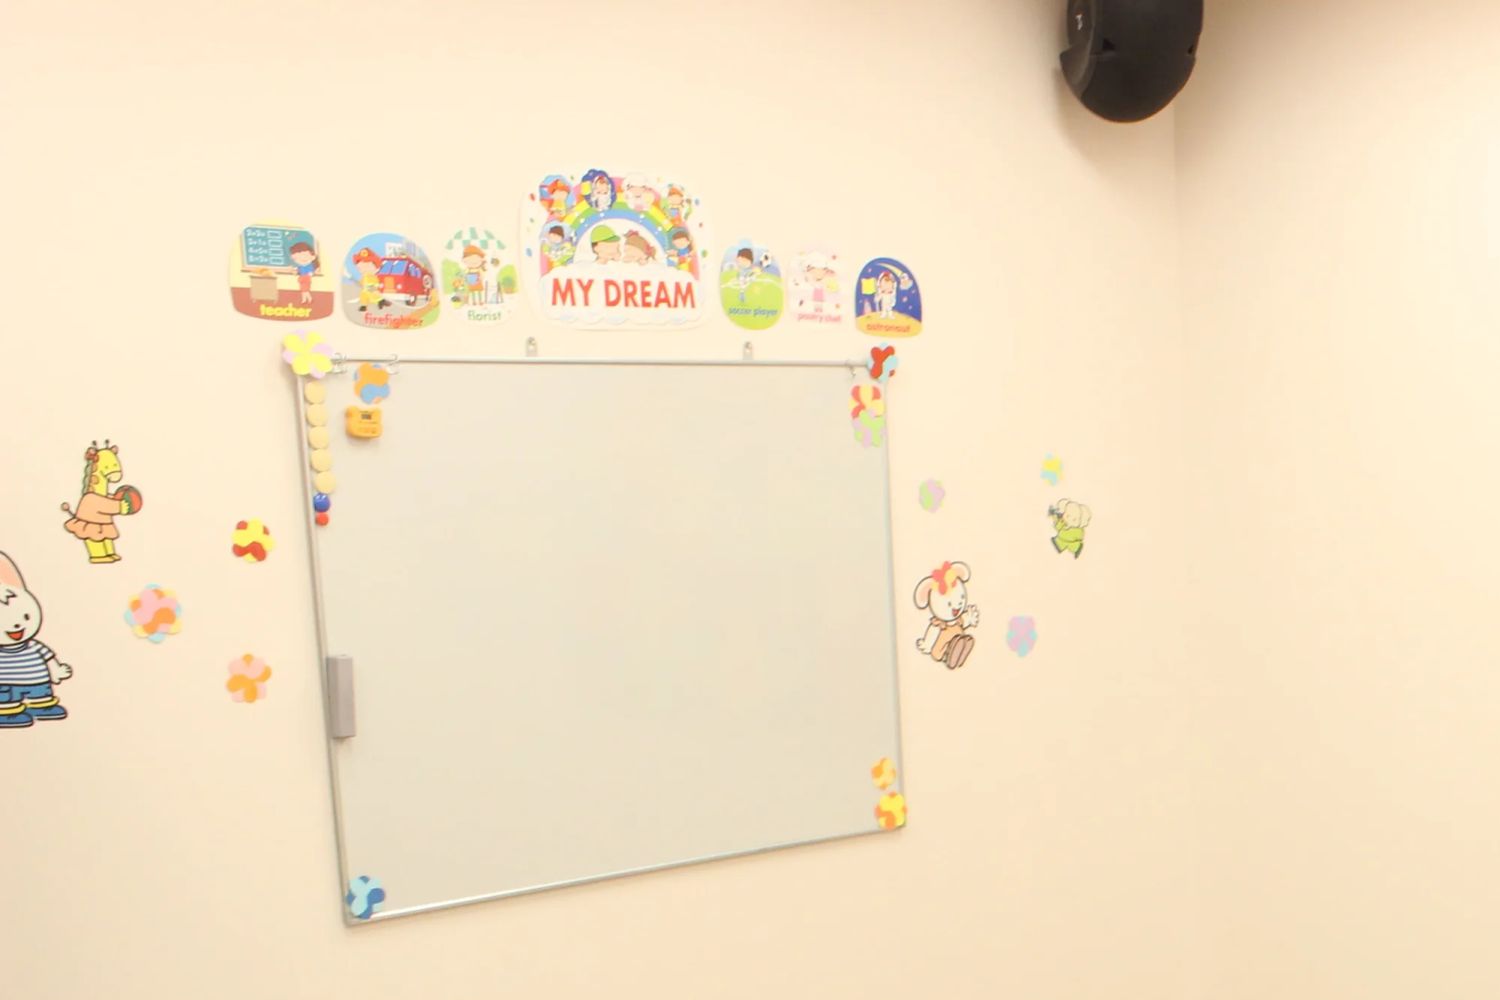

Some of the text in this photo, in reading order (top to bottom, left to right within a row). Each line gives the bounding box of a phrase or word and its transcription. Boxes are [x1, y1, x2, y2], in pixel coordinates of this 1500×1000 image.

[552, 278, 696, 309] MY DREAM
[260, 303, 312, 319] teacher
[467, 310, 502, 322] florist
[364, 313, 423, 328] firefighter
